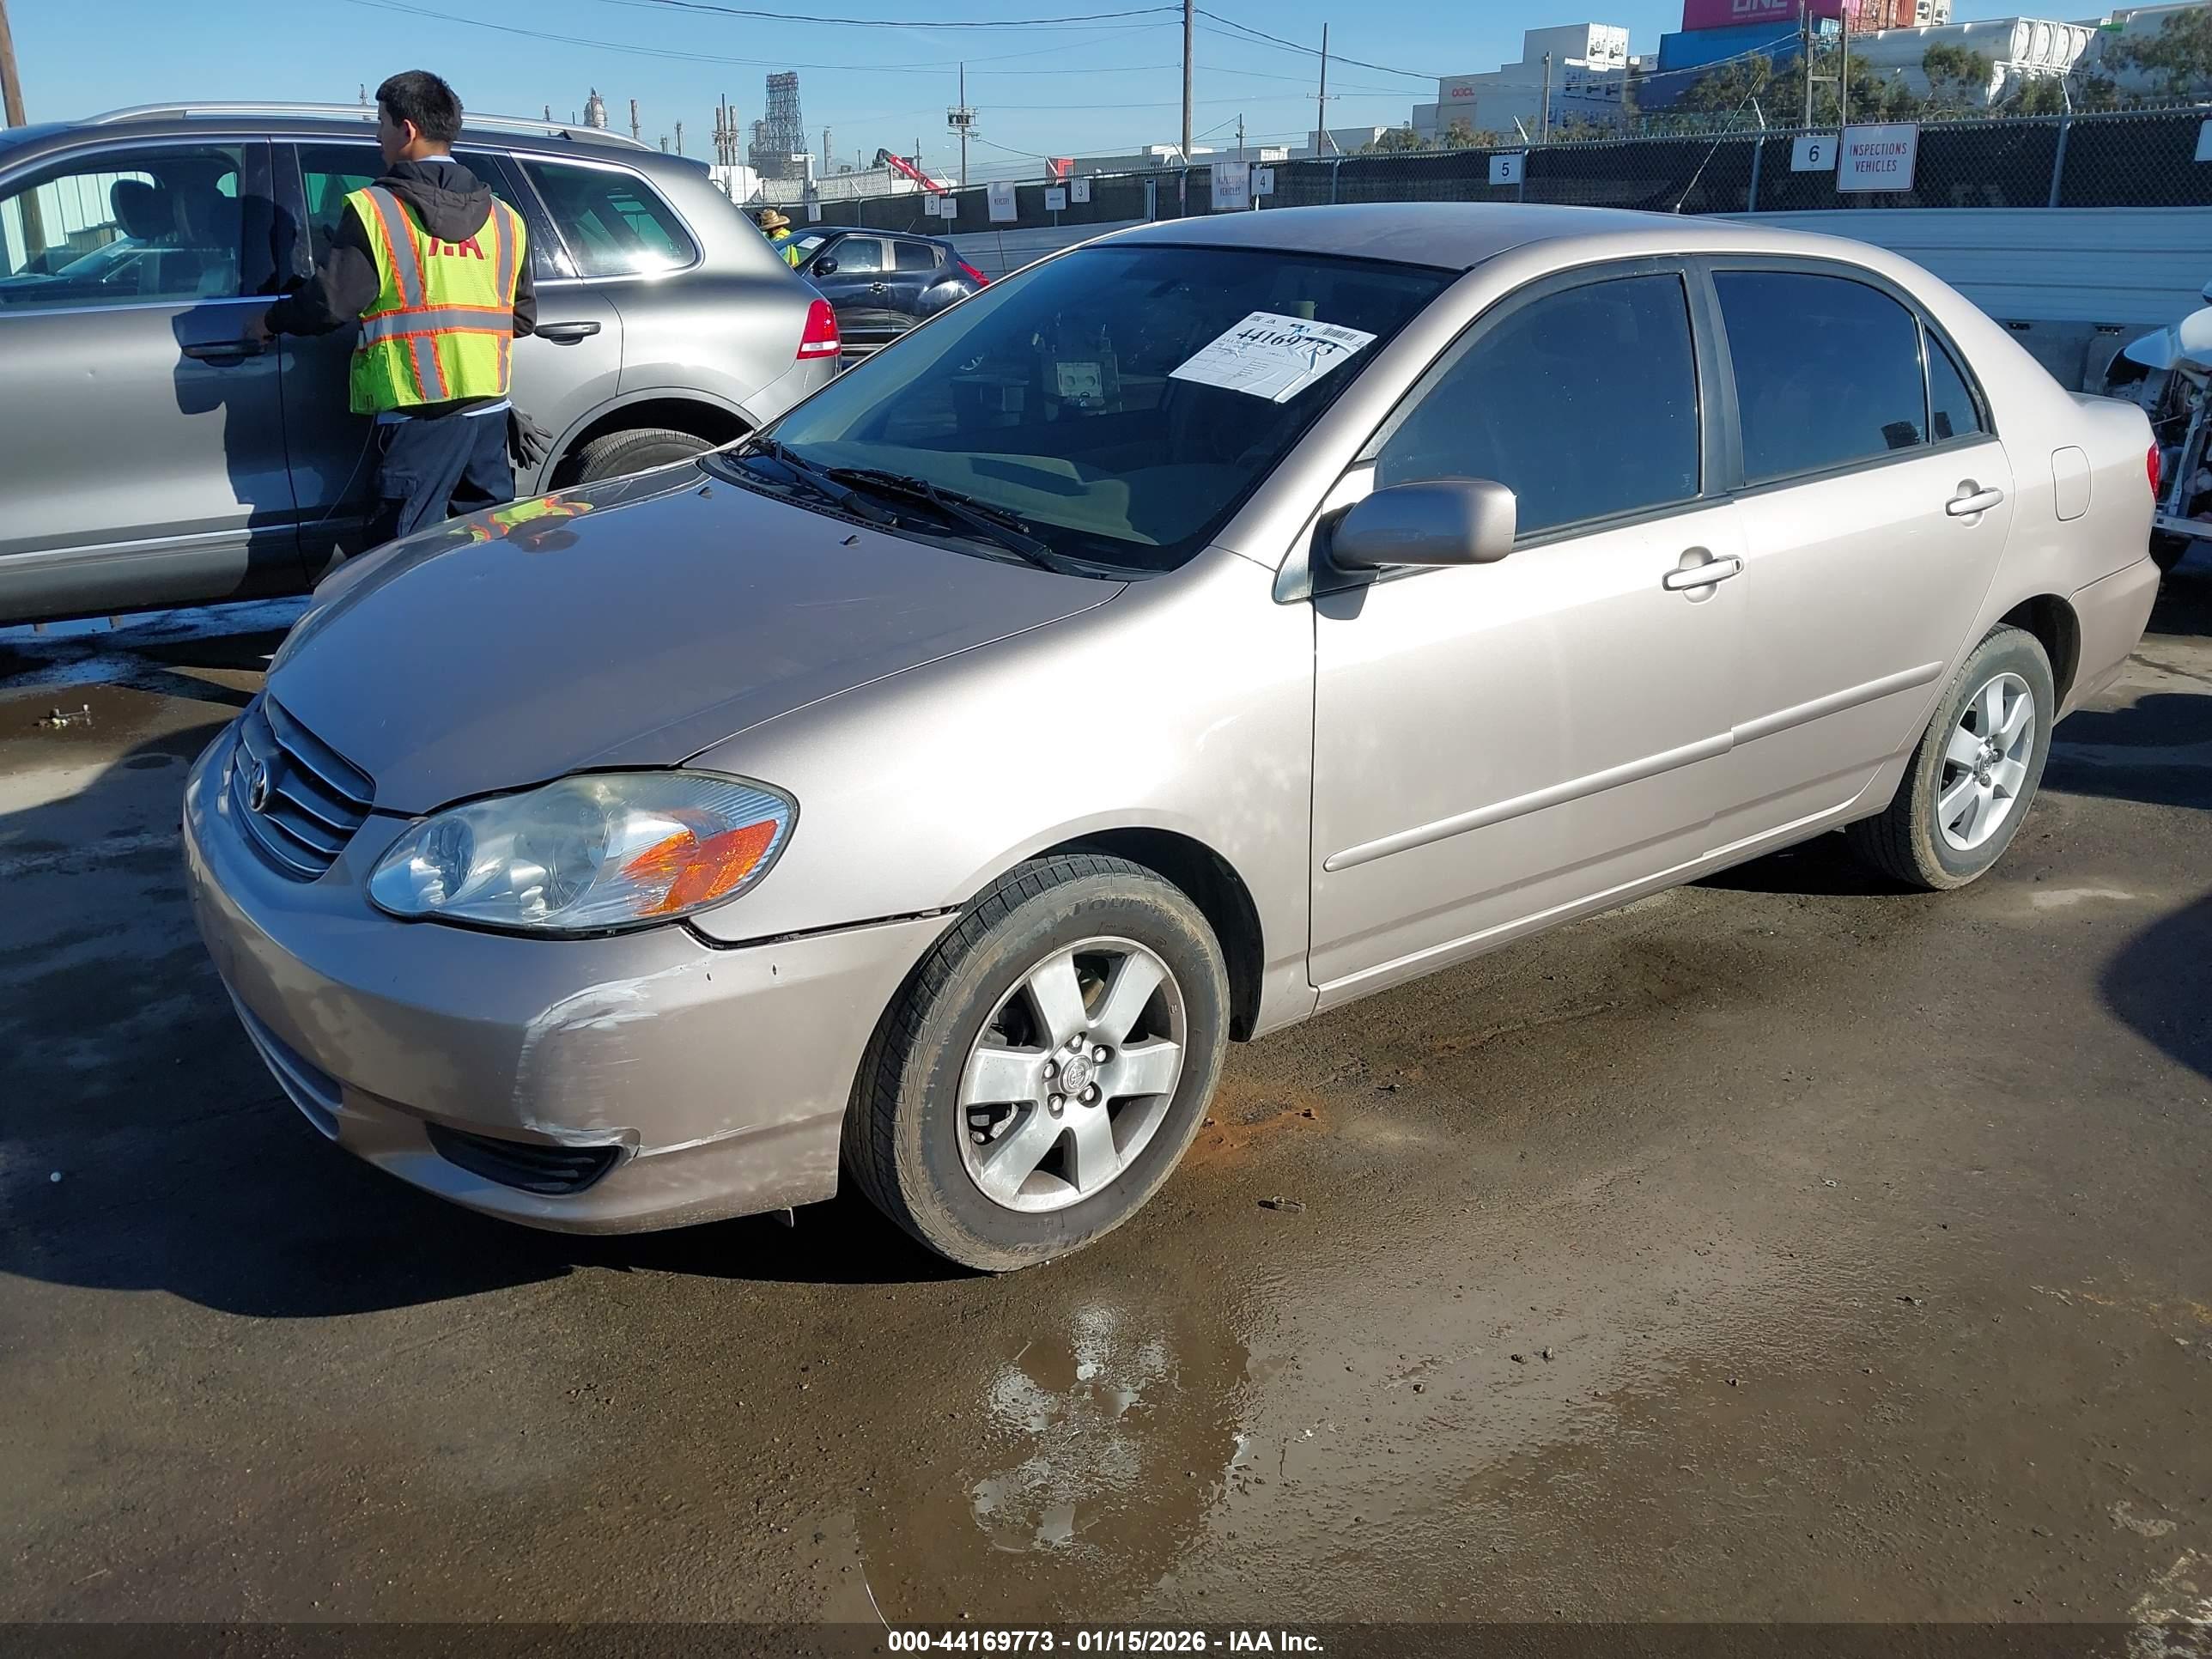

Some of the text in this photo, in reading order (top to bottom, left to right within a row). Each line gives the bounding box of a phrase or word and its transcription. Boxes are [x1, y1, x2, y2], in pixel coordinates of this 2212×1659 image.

[1808, 145, 1820, 162] 6
[1850, 143, 1908, 156] INSPECTIONS
[1501, 161, 1510, 177] 5
[1855, 160, 1898, 173] VEHICLES
[1260, 175, 1266, 189] 4
[1078, 185, 1083, 197] 3
[930, 199, 935, 210] 2
[1237, 327, 1339, 356] 44169773
